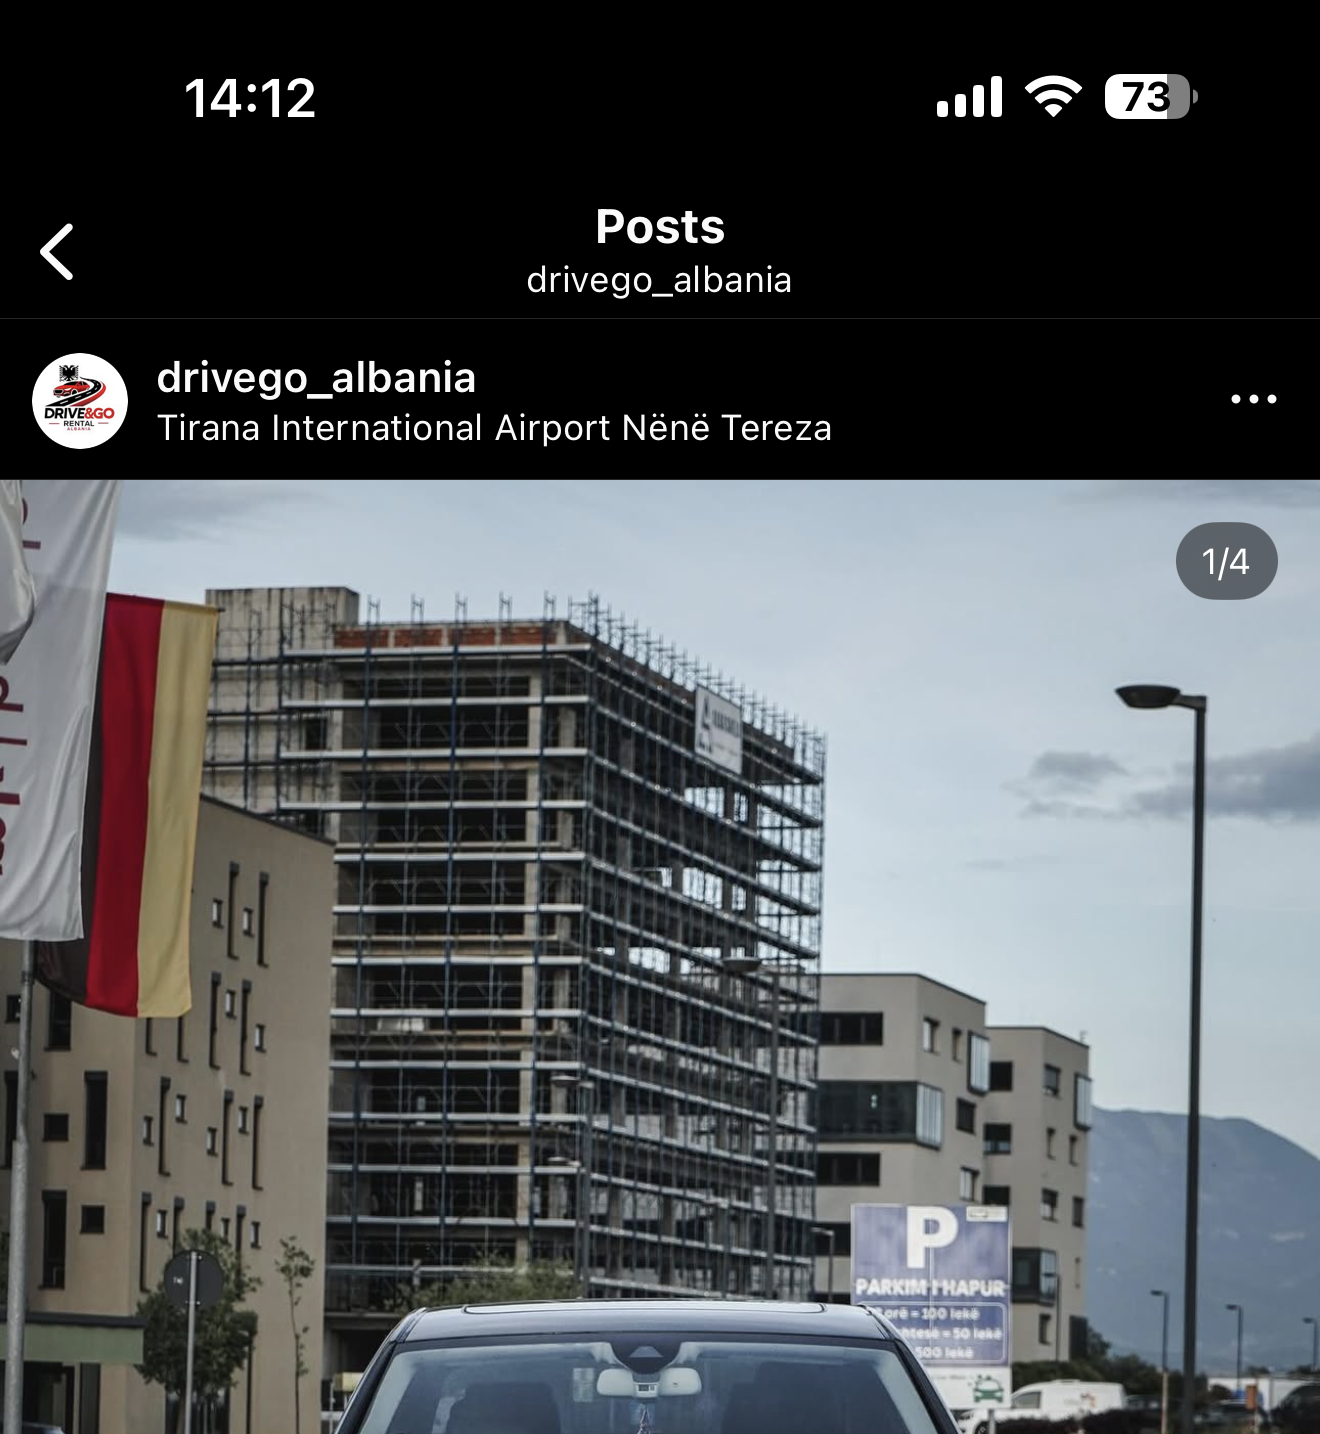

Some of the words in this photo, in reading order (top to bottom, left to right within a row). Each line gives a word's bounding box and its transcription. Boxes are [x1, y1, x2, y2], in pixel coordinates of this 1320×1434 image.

[907, 1207, 958, 1269] P
[855, 1278, 928, 1296] PARKIM
[942, 1279, 1006, 1297] HAPUR
[921, 1307, 948, 1320] 100
[950, 1307, 980, 1320] lekë
[899, 1326, 940, 1340] htesë
[952, 1328, 971, 1340] 50
[973, 1327, 1002, 1340] lekë
